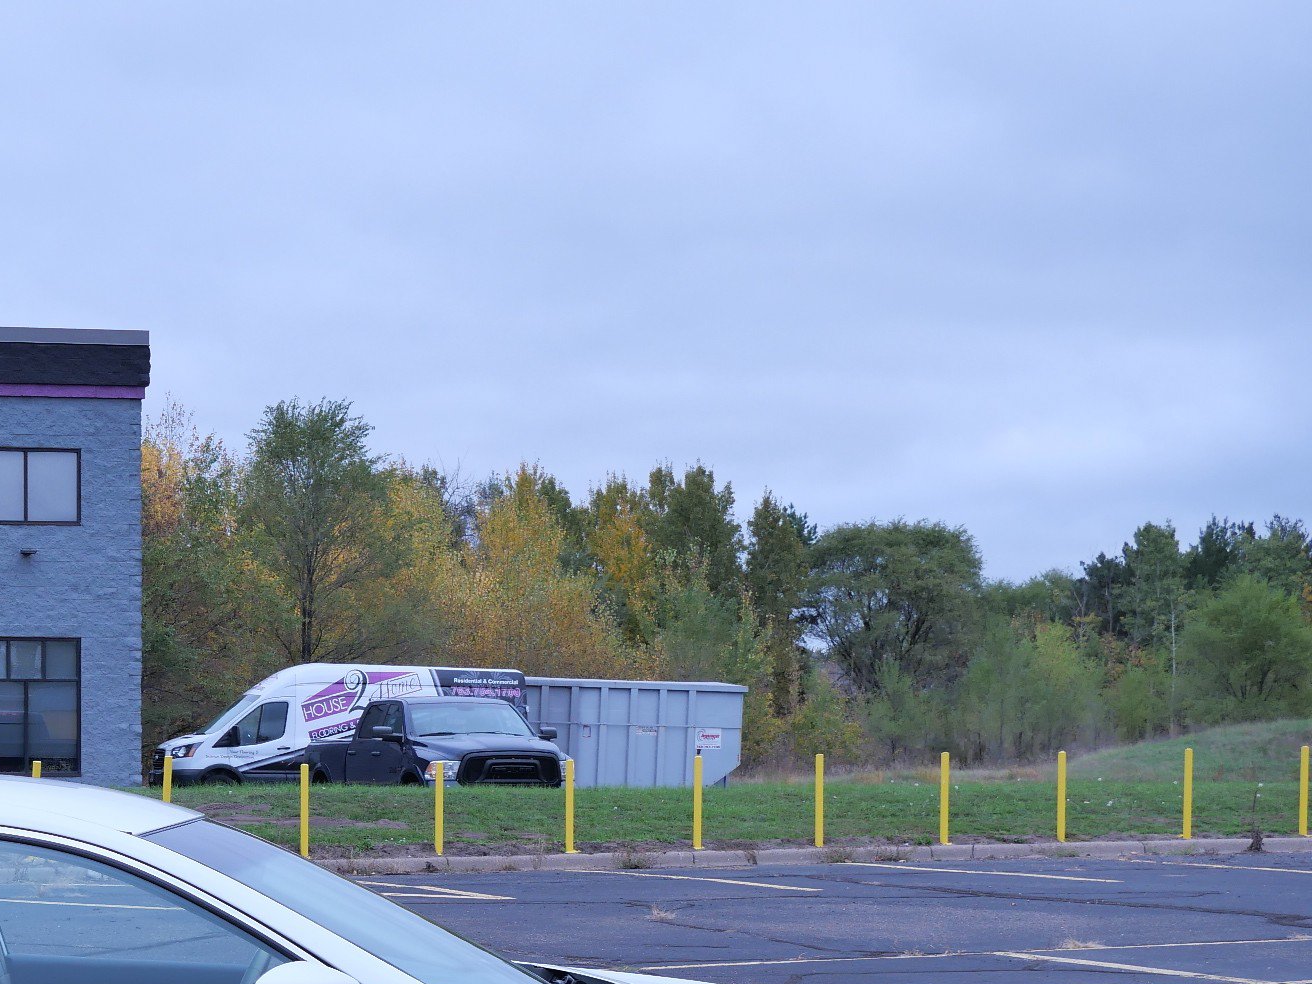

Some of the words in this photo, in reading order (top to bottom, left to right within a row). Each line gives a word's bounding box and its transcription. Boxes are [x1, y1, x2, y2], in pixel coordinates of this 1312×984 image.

[303, 696, 348, 720] HOUSE
[311, 723, 348, 740] FLOORING
[349, 721, 356, 729] &
